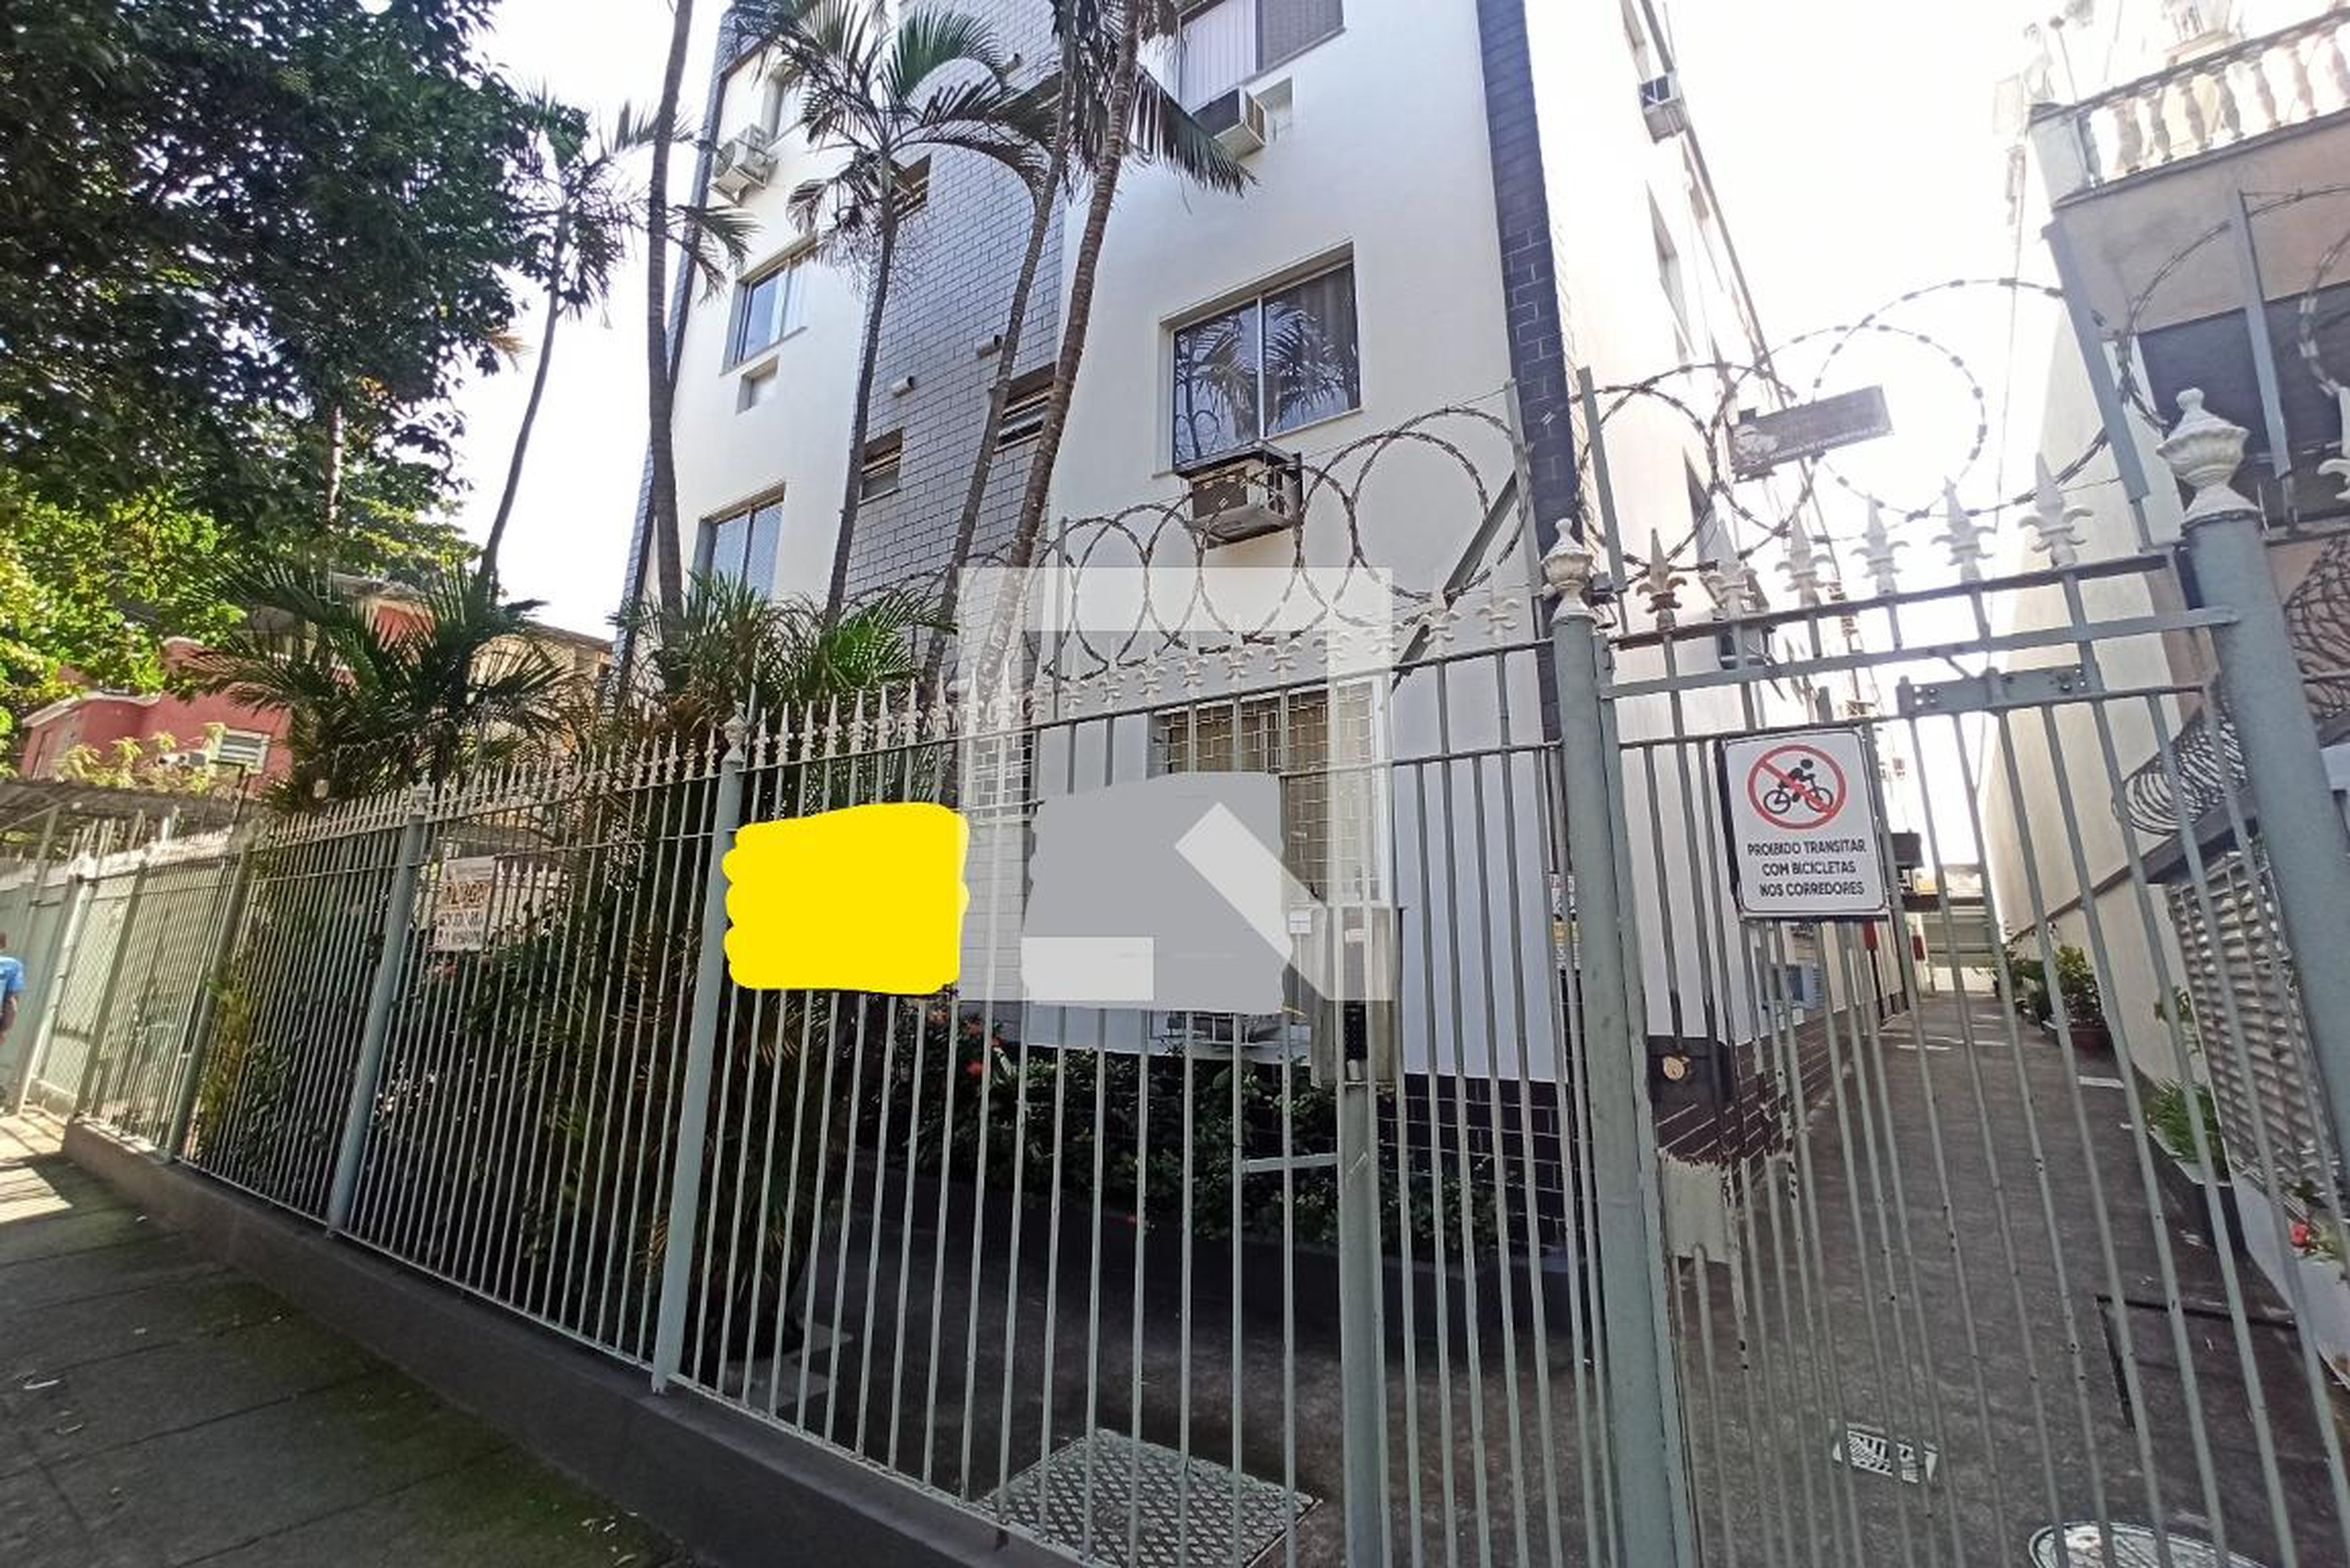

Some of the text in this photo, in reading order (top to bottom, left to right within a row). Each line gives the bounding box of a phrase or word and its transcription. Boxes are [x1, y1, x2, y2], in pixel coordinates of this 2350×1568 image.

[1747, 839, 1867, 856] PROIBIDO TRANSITAR
[1762, 861, 1856, 876] COM BICICLETAS
[1759, 881, 1864, 897] NOS CORREDORES
